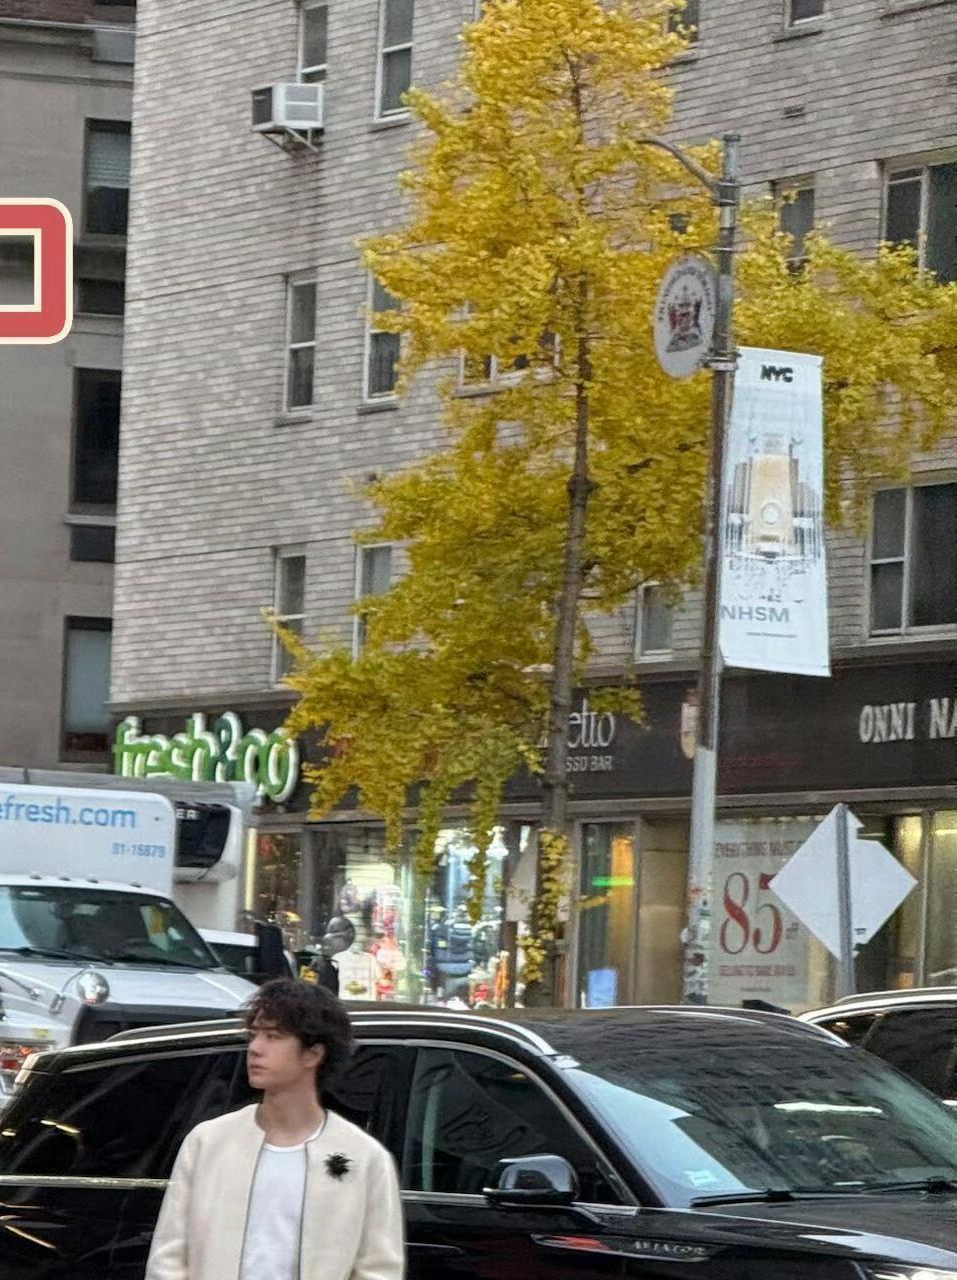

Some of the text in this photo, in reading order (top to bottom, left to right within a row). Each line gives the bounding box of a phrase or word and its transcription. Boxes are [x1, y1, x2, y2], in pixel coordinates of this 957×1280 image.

[760, 365, 793, 383] NYC
[721, 605, 790, 622] NHSM
[566, 698, 615, 748] etto
[859, 702, 917, 744] ONNI
[566, 755, 612, 772] SSO BAR
[176, 808, 197, 820] ER
[720, 872, 783, 955] 85
